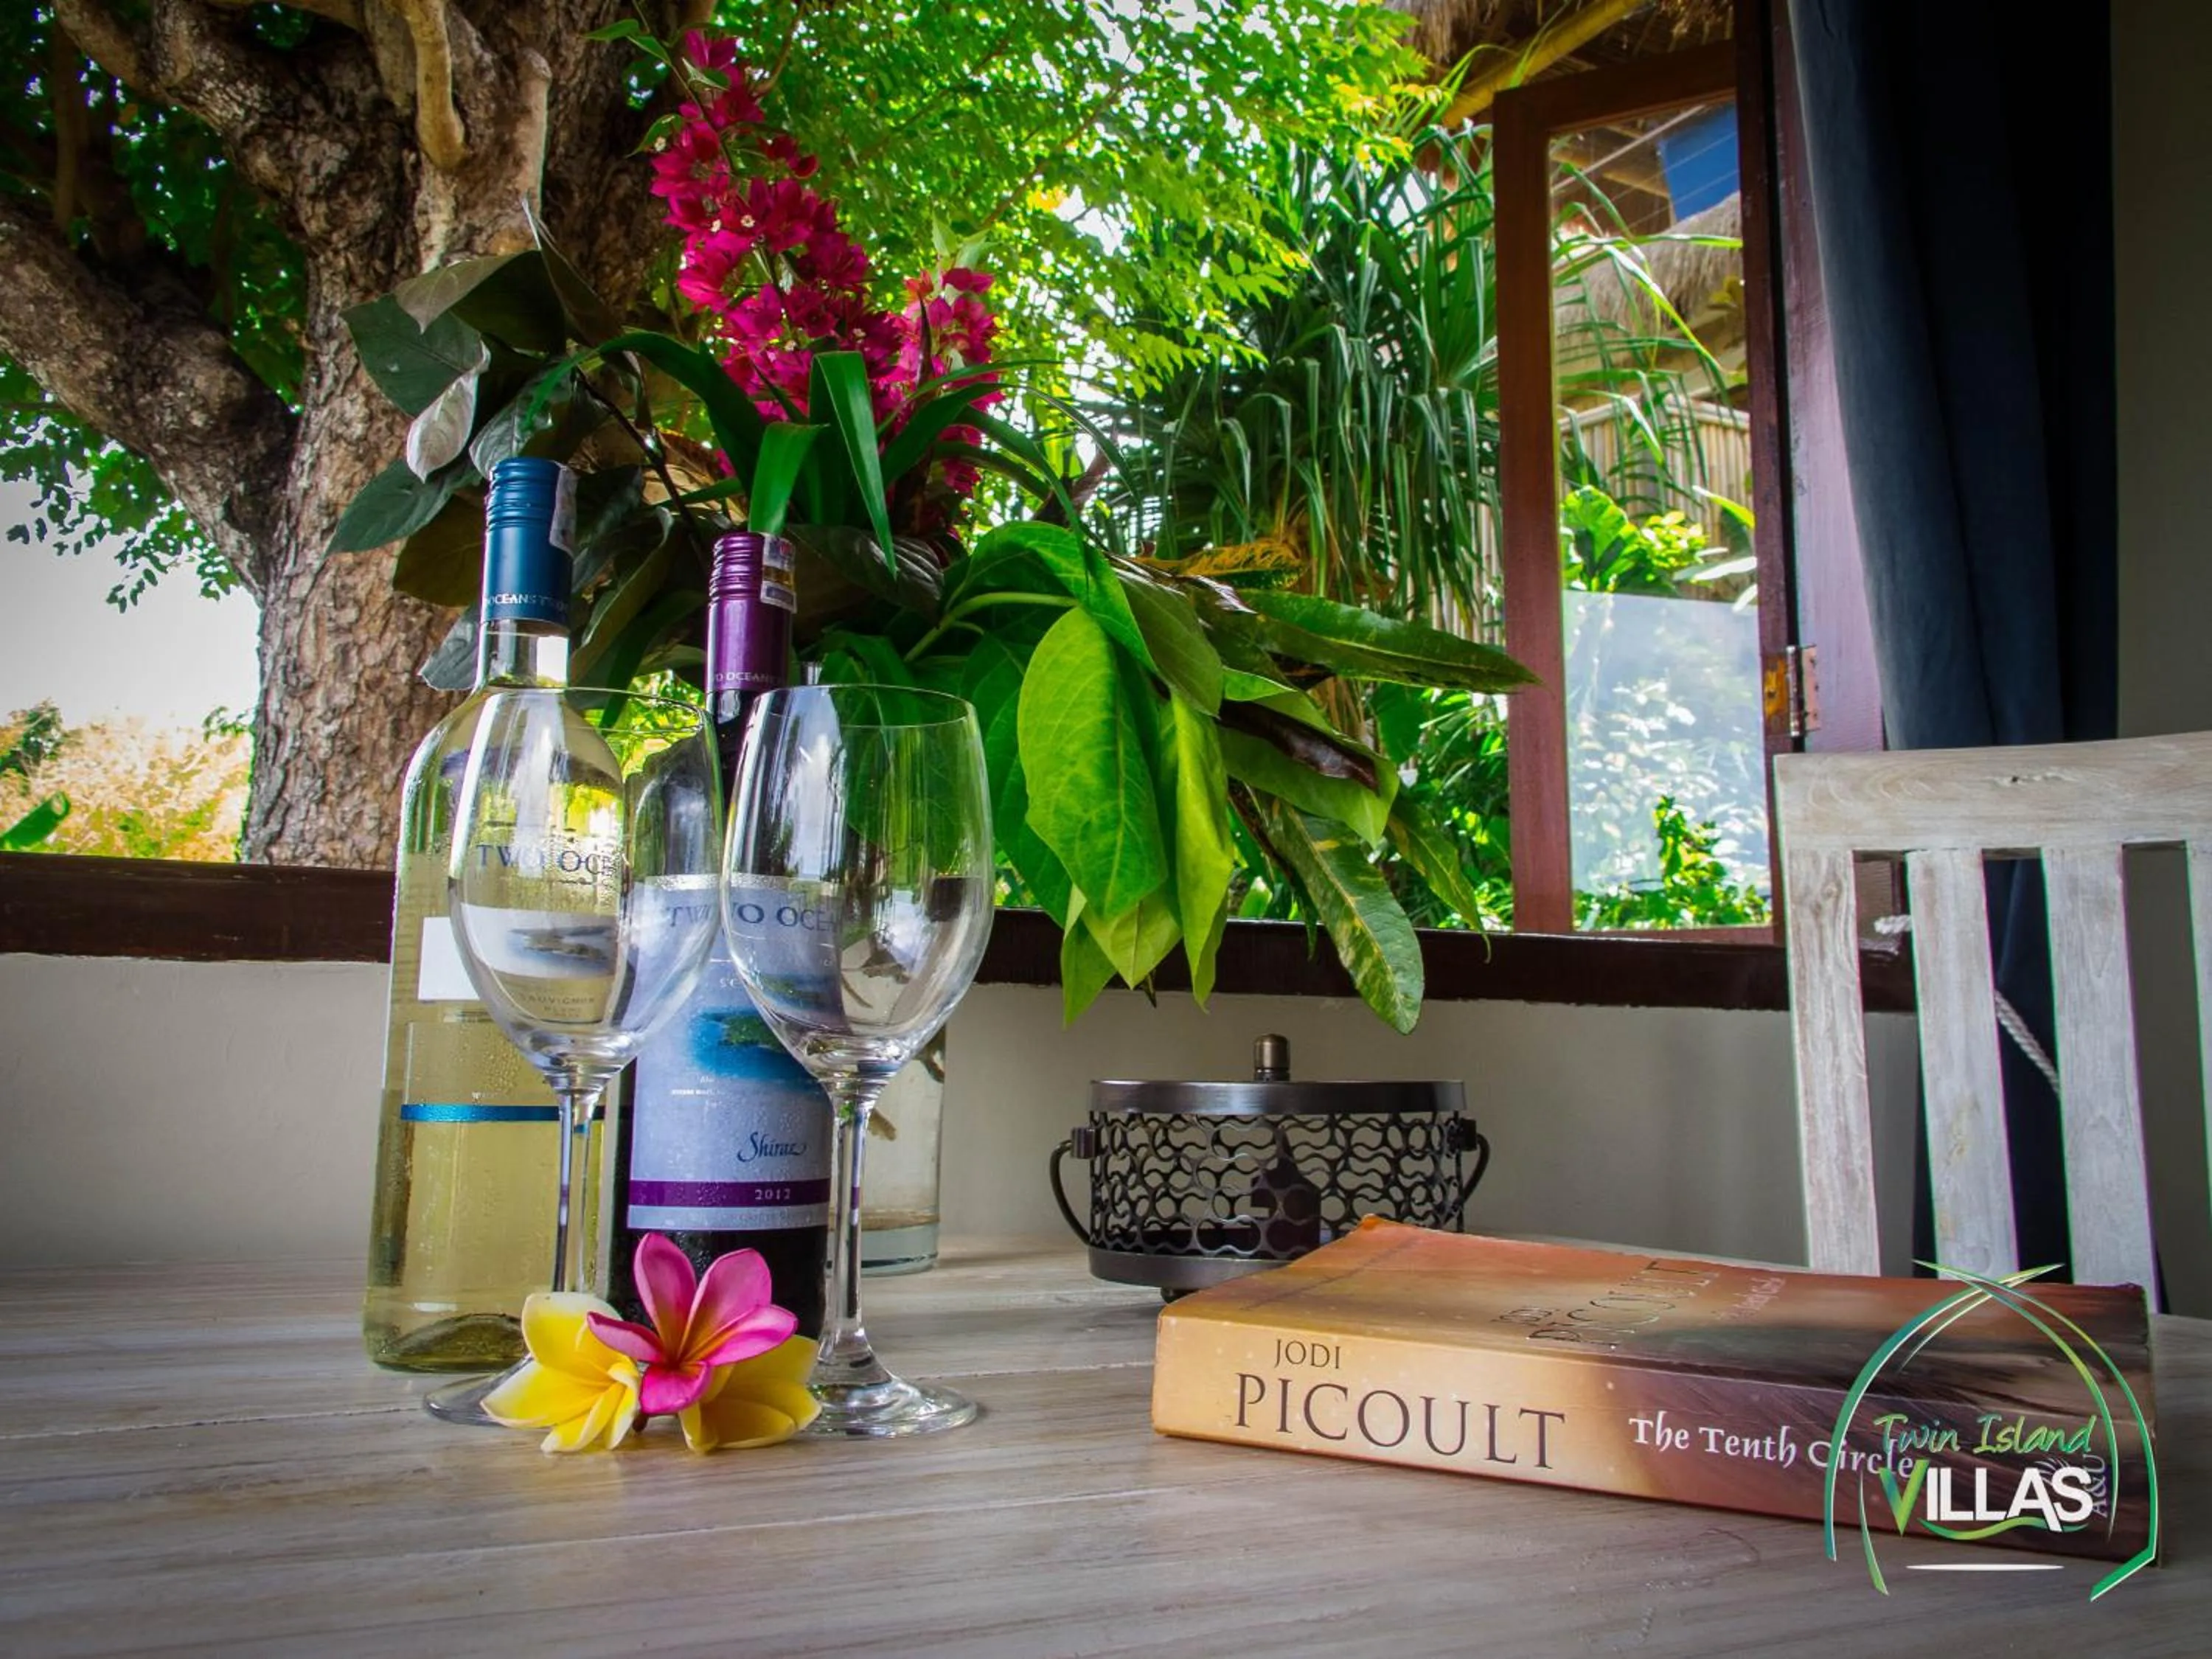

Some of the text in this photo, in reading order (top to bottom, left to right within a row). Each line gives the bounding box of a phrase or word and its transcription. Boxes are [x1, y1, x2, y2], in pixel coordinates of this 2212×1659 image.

[737, 1131, 807, 1163] Shiraz
[755, 1189, 791, 1200] 2012
[1274, 1338, 1342, 1370] JODI
[1234, 1372, 1566, 1470] PICOULT
[1629, 1411, 1690, 1452] The
[1698, 1425, 1798, 1469] Tenth
